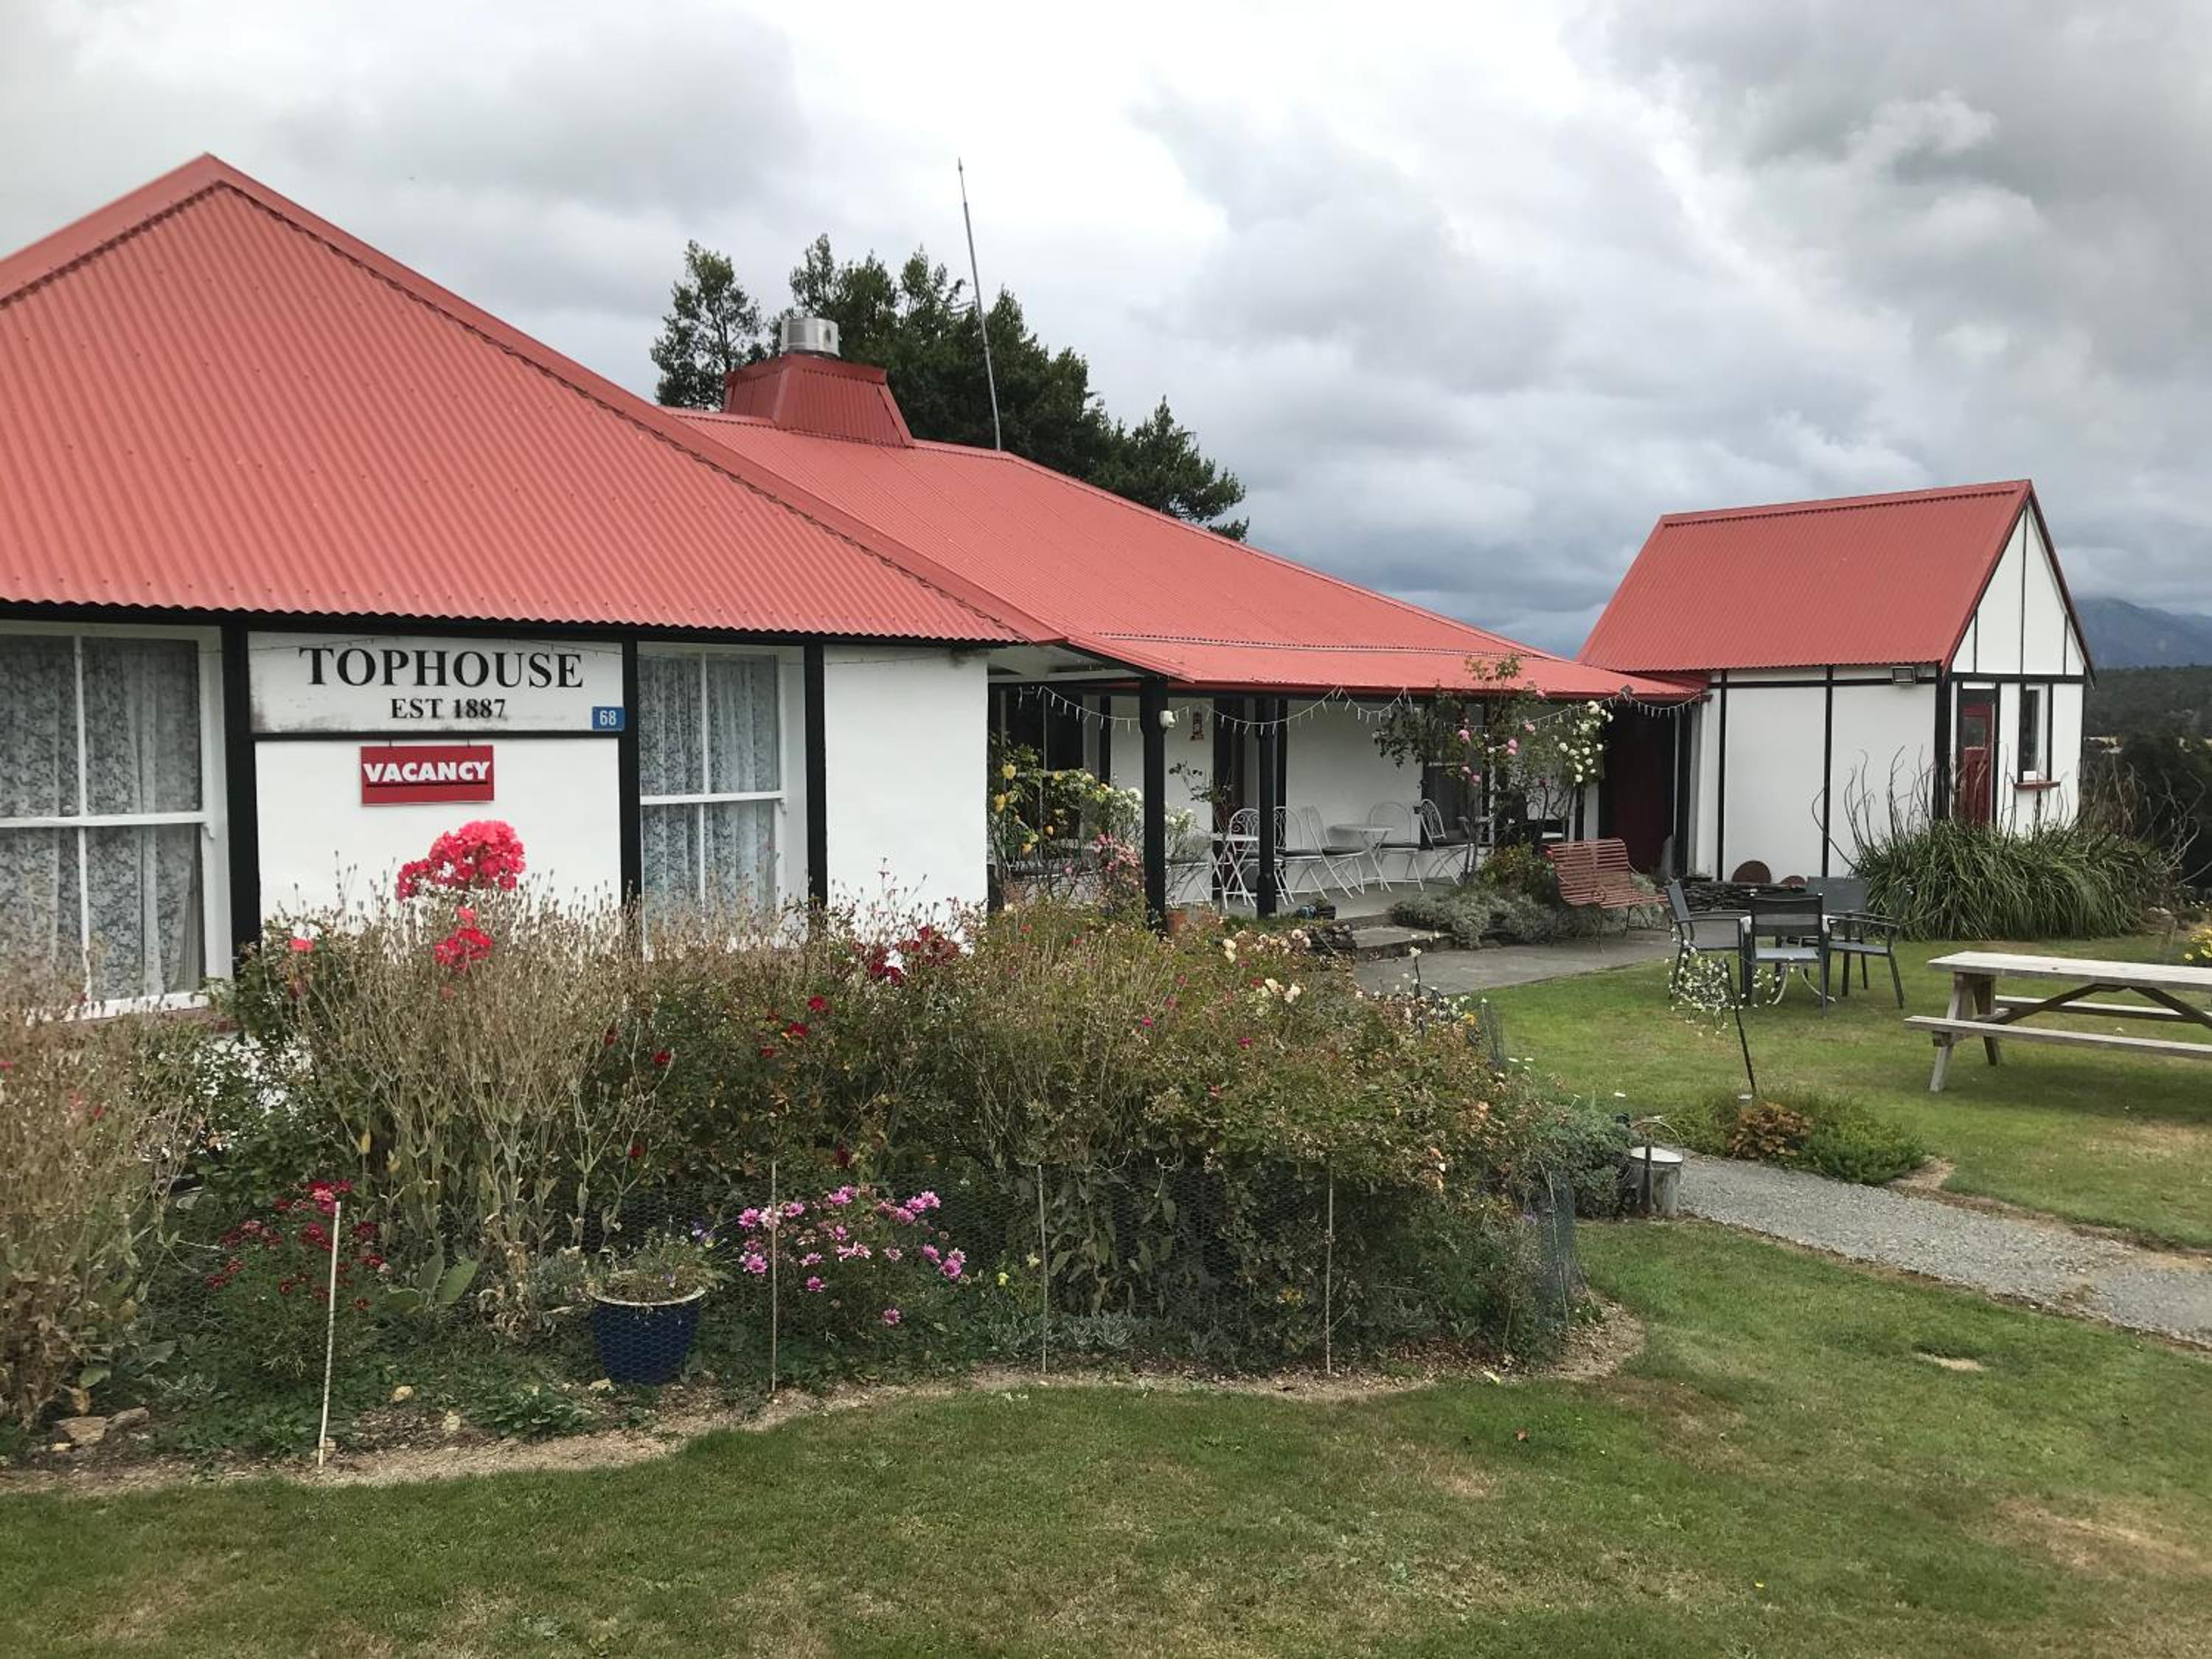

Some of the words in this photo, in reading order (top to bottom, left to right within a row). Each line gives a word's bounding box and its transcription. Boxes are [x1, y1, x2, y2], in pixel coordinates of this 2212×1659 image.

[299, 647, 584, 689] TOPHOUSE
[390, 698, 443, 720] EST
[453, 698, 507, 720] 1887
[599, 709, 617, 727] 68
[363, 759, 490, 783] VACANCY
